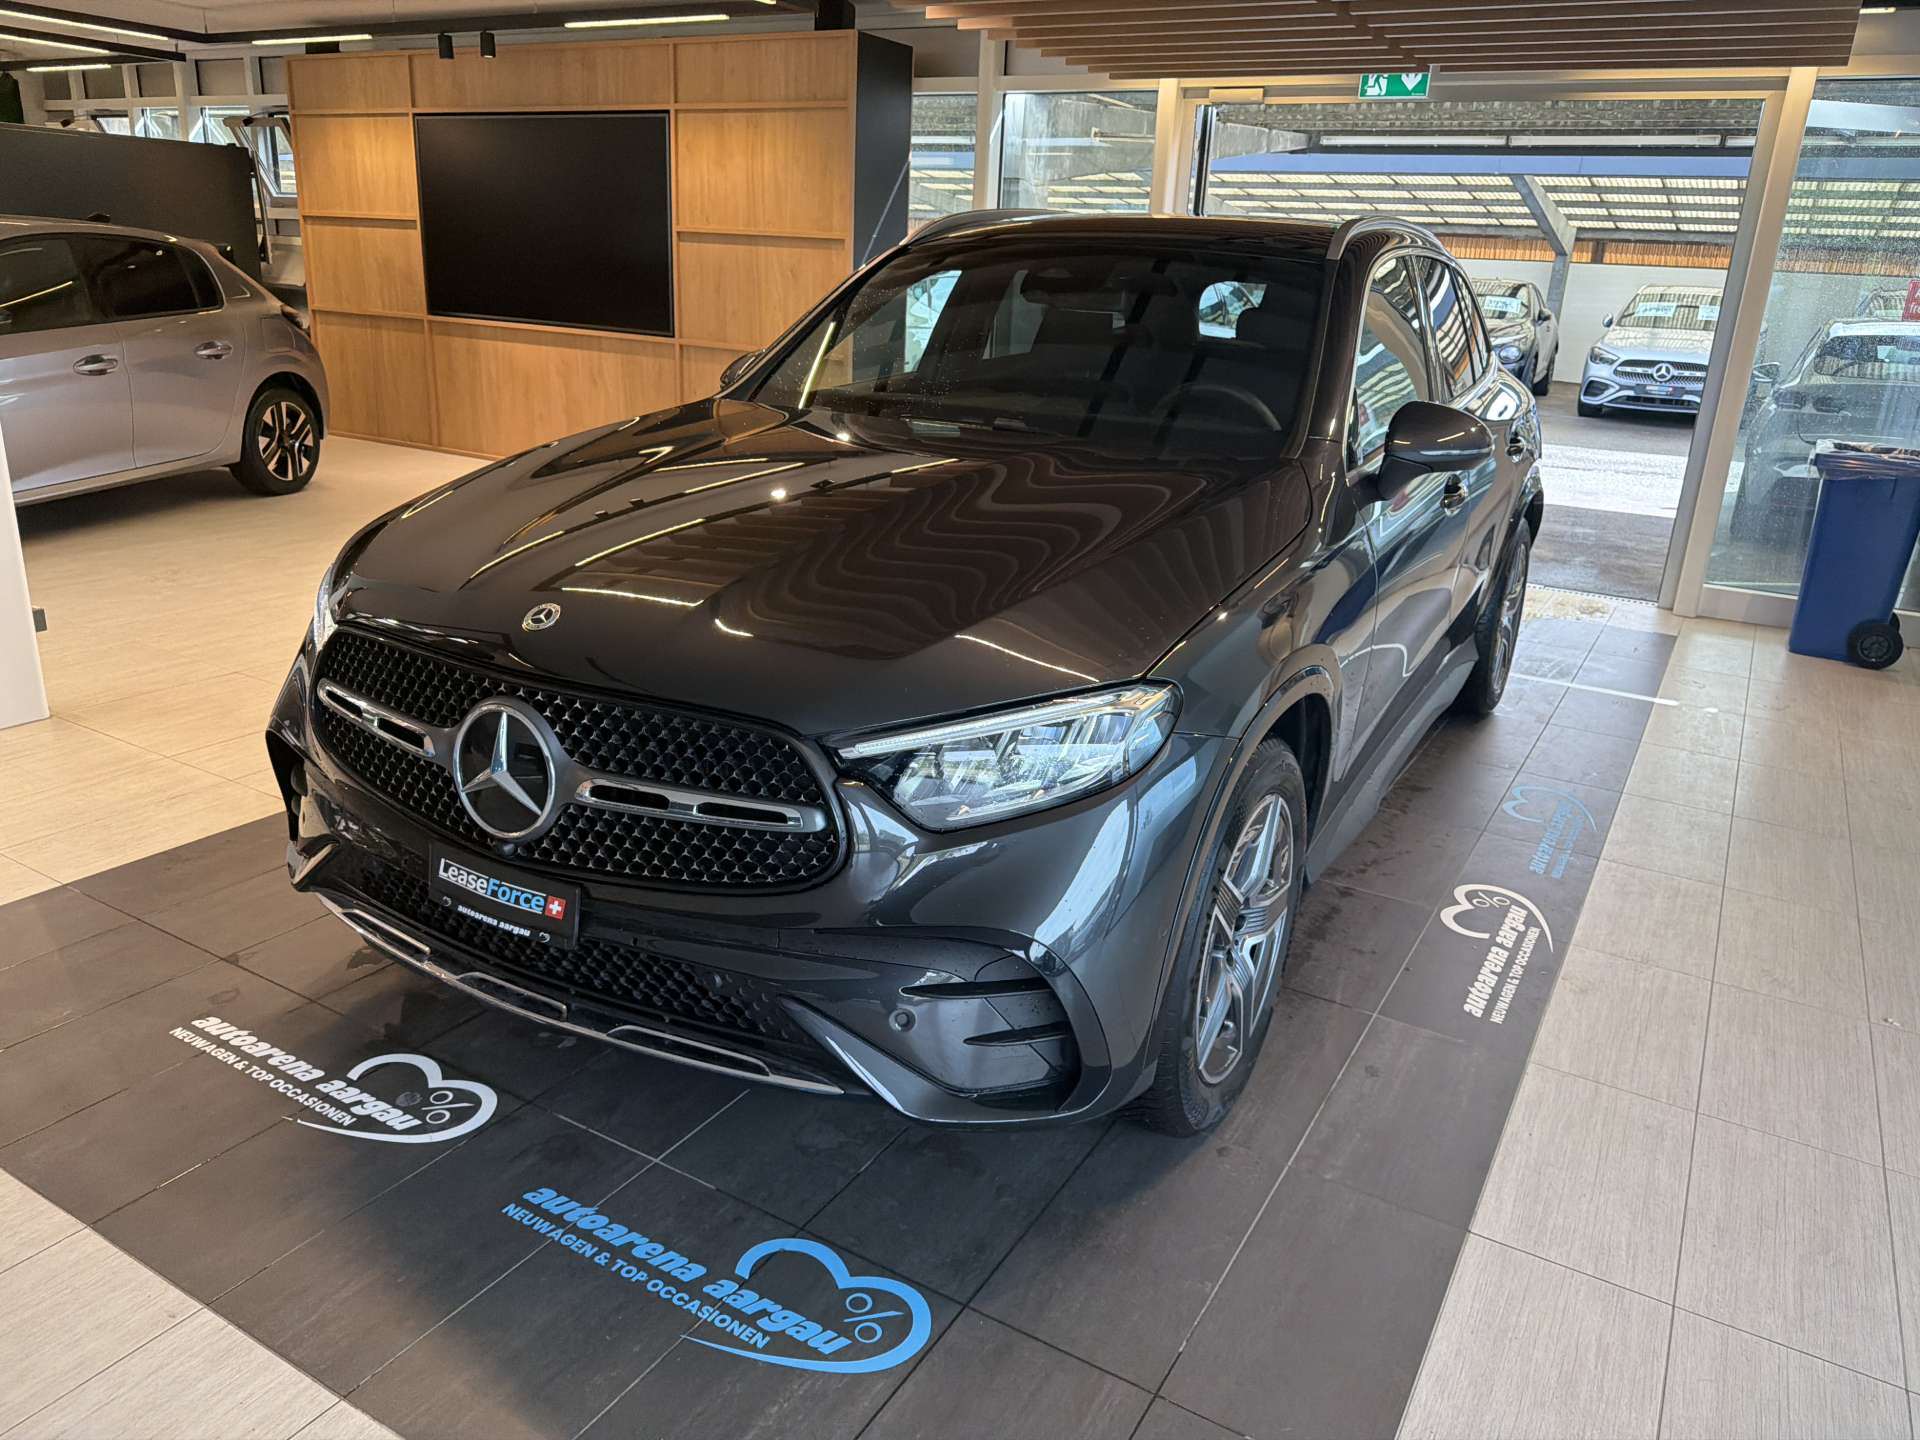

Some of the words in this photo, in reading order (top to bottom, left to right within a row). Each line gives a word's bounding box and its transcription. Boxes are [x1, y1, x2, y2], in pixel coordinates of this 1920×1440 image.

[439, 858, 545, 912] LeaseForce
[457, 904, 498, 926] autoarena
[498, 920, 531, 937] aargau
[1463, 945, 1510, 1018] autoarena
[1495, 904, 1528, 948] aargau
[1509, 964, 1525, 979] TOP
[1515, 926, 1541, 966] OCCASIONEN
[1489, 982, 1519, 1024] NEUWAGEN
[169, 1026, 239, 1065] NEUWAGEN
[233, 1060, 249, 1071] &
[245, 1065, 275, 1082] TOP
[269, 1079, 357, 1127] OCCASIONEN
[191, 1016, 326, 1082] autoarena
[315, 1079, 423, 1131] aargau
[501, 1203, 599, 1258] NEUWAGEN
[593, 1252, 611, 1266] &
[609, 1259, 649, 1283] TOP
[646, 1279, 771, 1349] OCCASIONEN
[523, 1187, 707, 1282] autoarena
[702, 1279, 852, 1355] aargau
